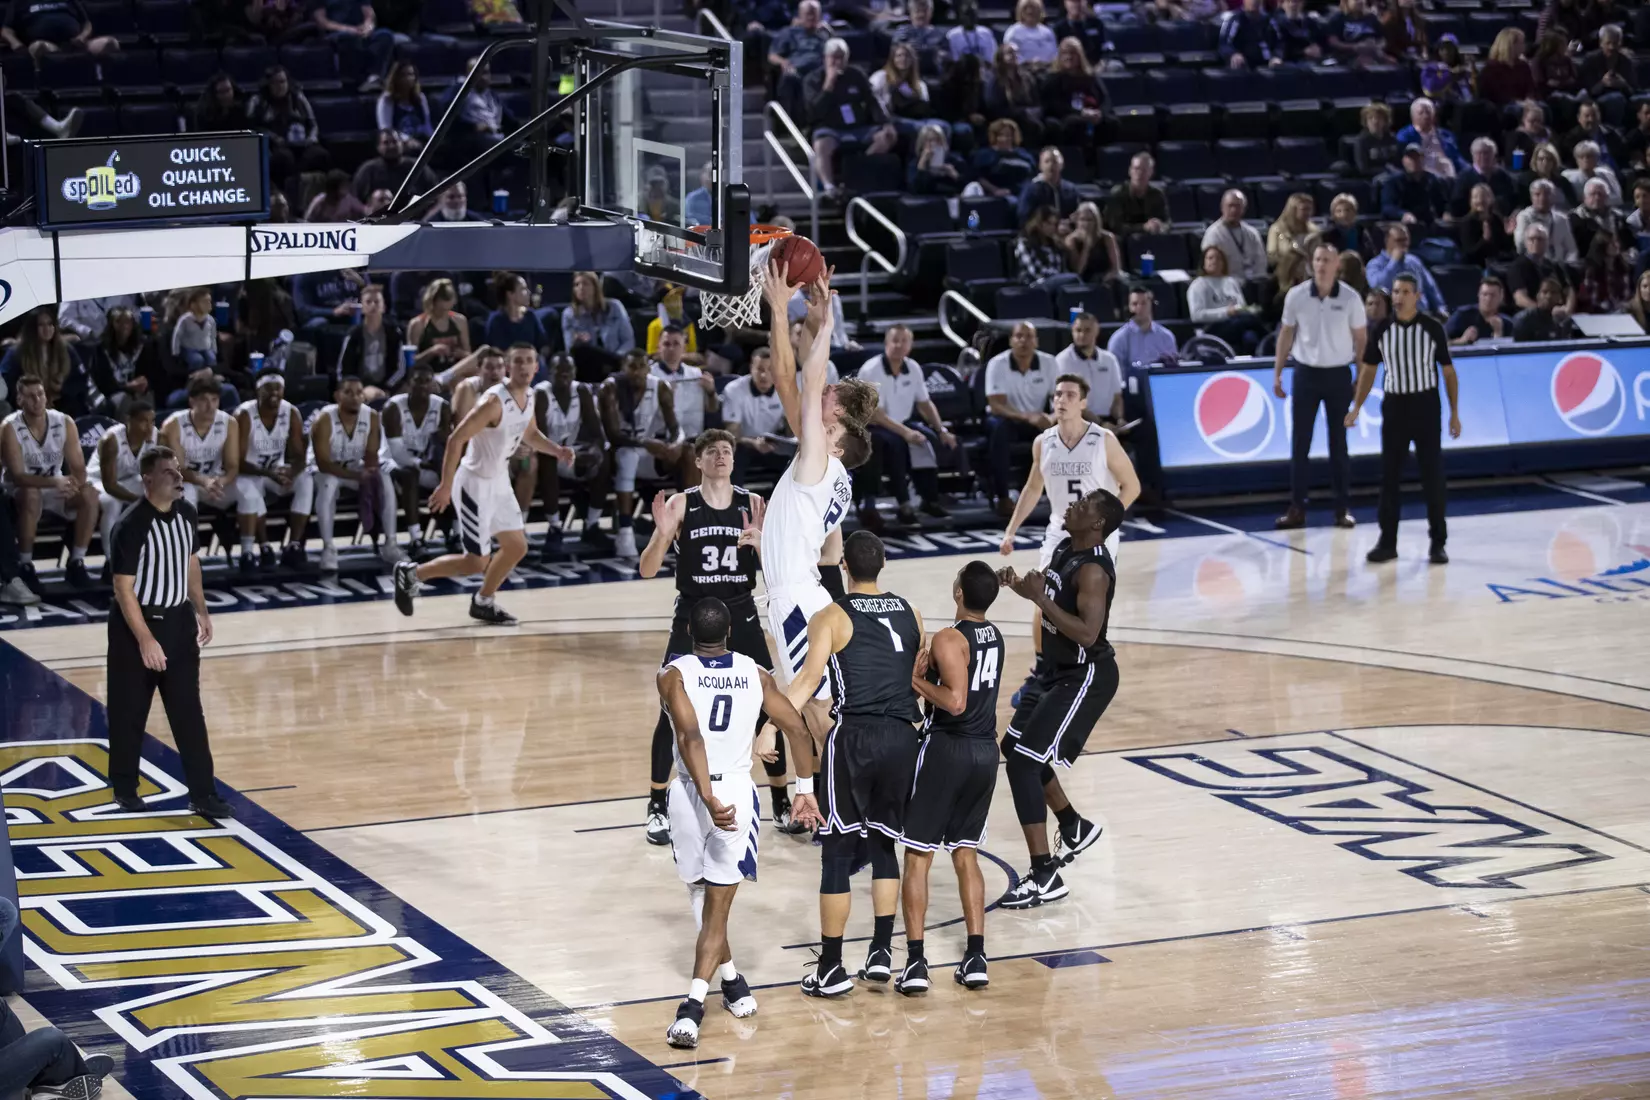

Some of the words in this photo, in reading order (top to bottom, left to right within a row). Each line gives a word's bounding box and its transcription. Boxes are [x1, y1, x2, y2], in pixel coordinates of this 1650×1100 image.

[170, 147, 226, 165] QUICK.
[162, 168, 236, 186] QUALITY.
[149, 192, 176, 208] OIL
[178, 188, 251, 205] CHANGE.
[251, 228, 357, 254] SPALDING
[1067, 479, 1083, 507] 5
[690, 525, 744, 540] CENTRA
[701, 545, 739, 572] 34
[850, 598, 906, 613] BERGERSEN
[878, 617, 904, 652] 1
[970, 646, 999, 692] 14
[698, 675, 749, 690] ACQUAAH
[708, 694, 733, 732] 0
